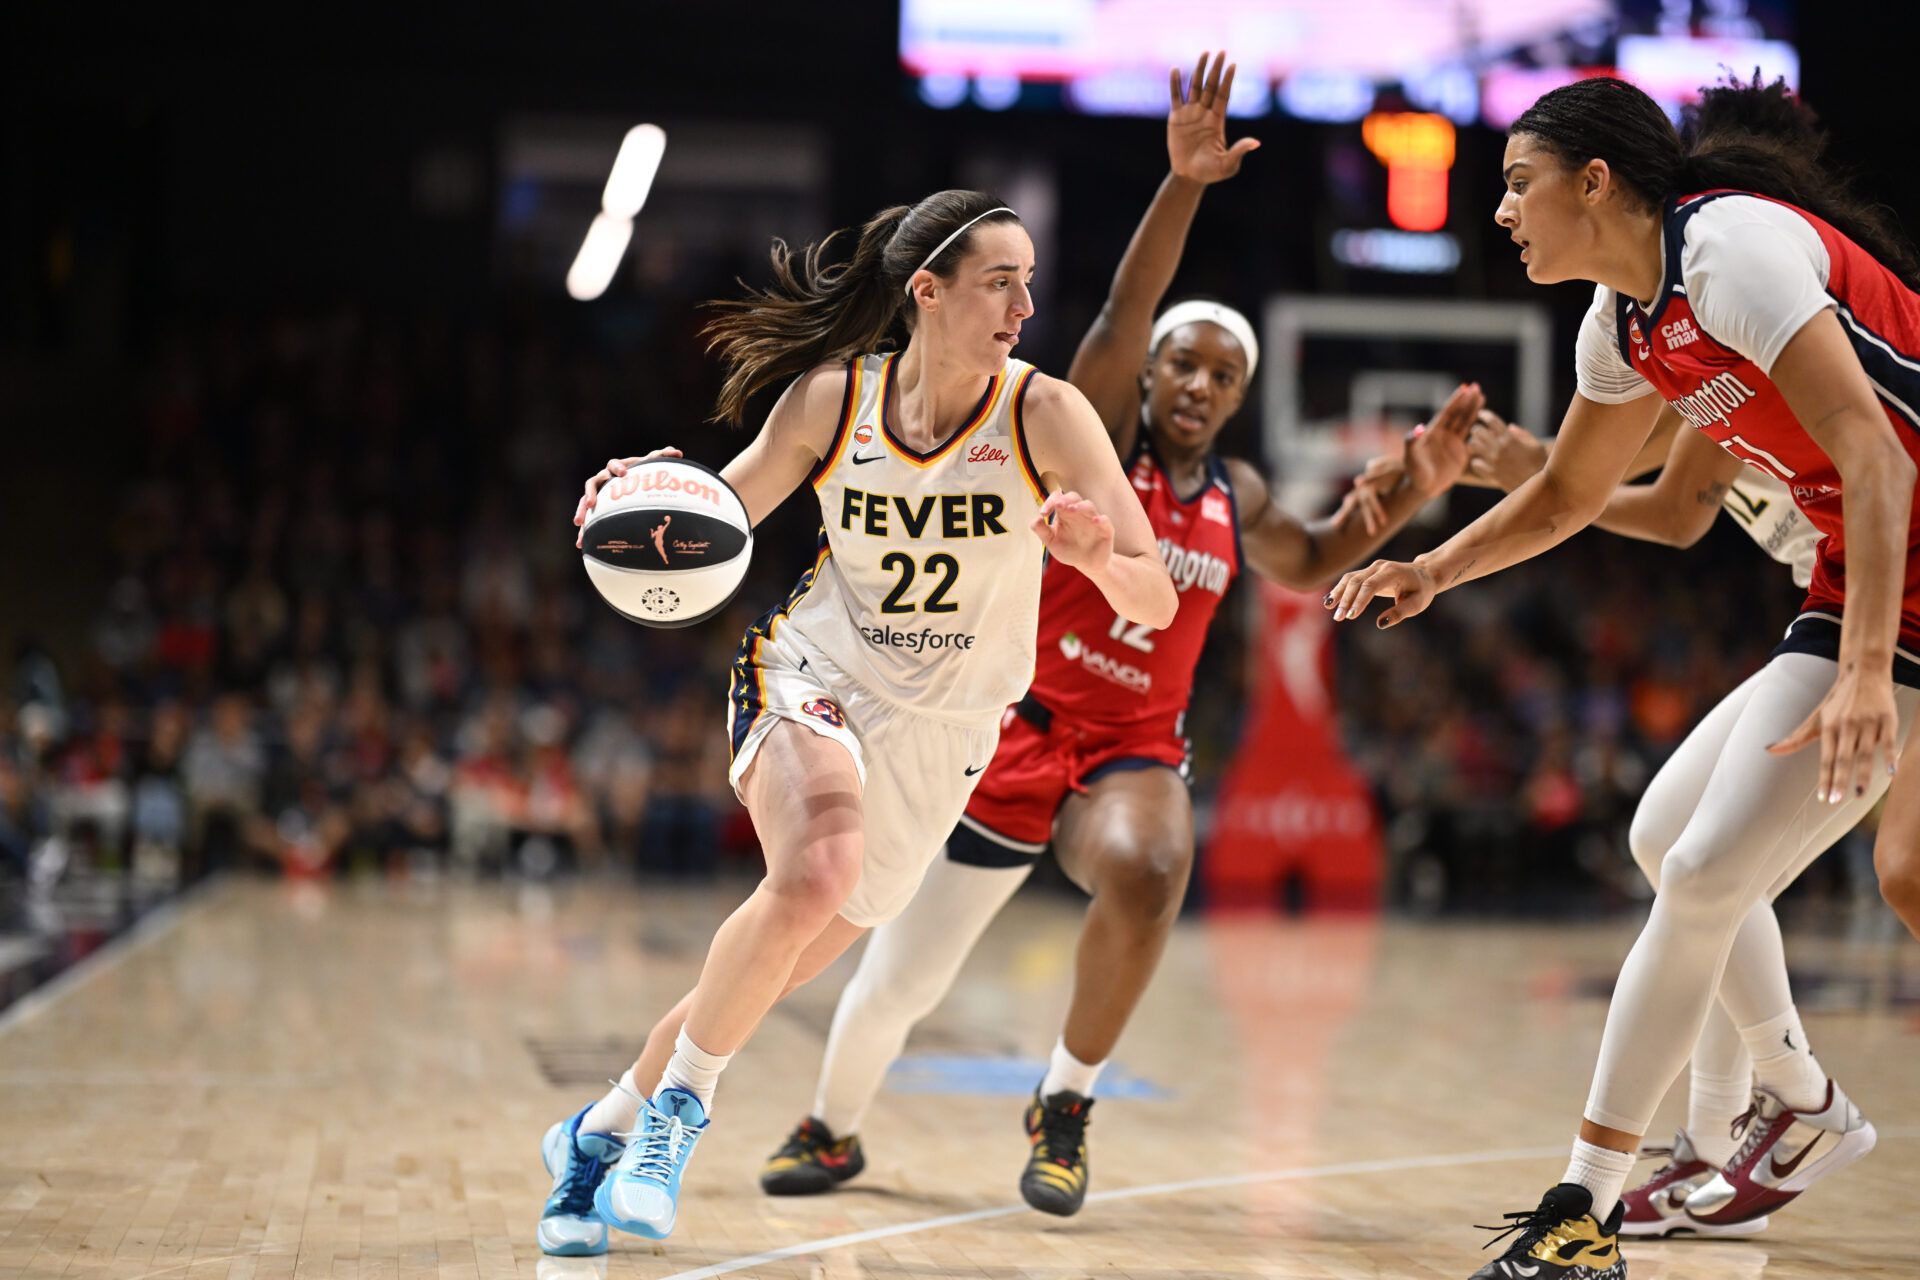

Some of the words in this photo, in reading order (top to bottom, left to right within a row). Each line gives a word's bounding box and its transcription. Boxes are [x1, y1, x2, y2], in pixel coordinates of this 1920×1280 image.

[1661, 318, 1691, 338] CAR
[1666, 328, 1699, 350] max
[967, 444, 1009, 466] Lilly
[609, 470, 720, 505] Wilson
[840, 486, 1009, 539] FEVER
[880, 551, 960, 614] 22
[1157, 538, 1231, 598] ington
[861, 625, 976, 653] salesforce
[1081, 644, 1153, 692] VANDA
